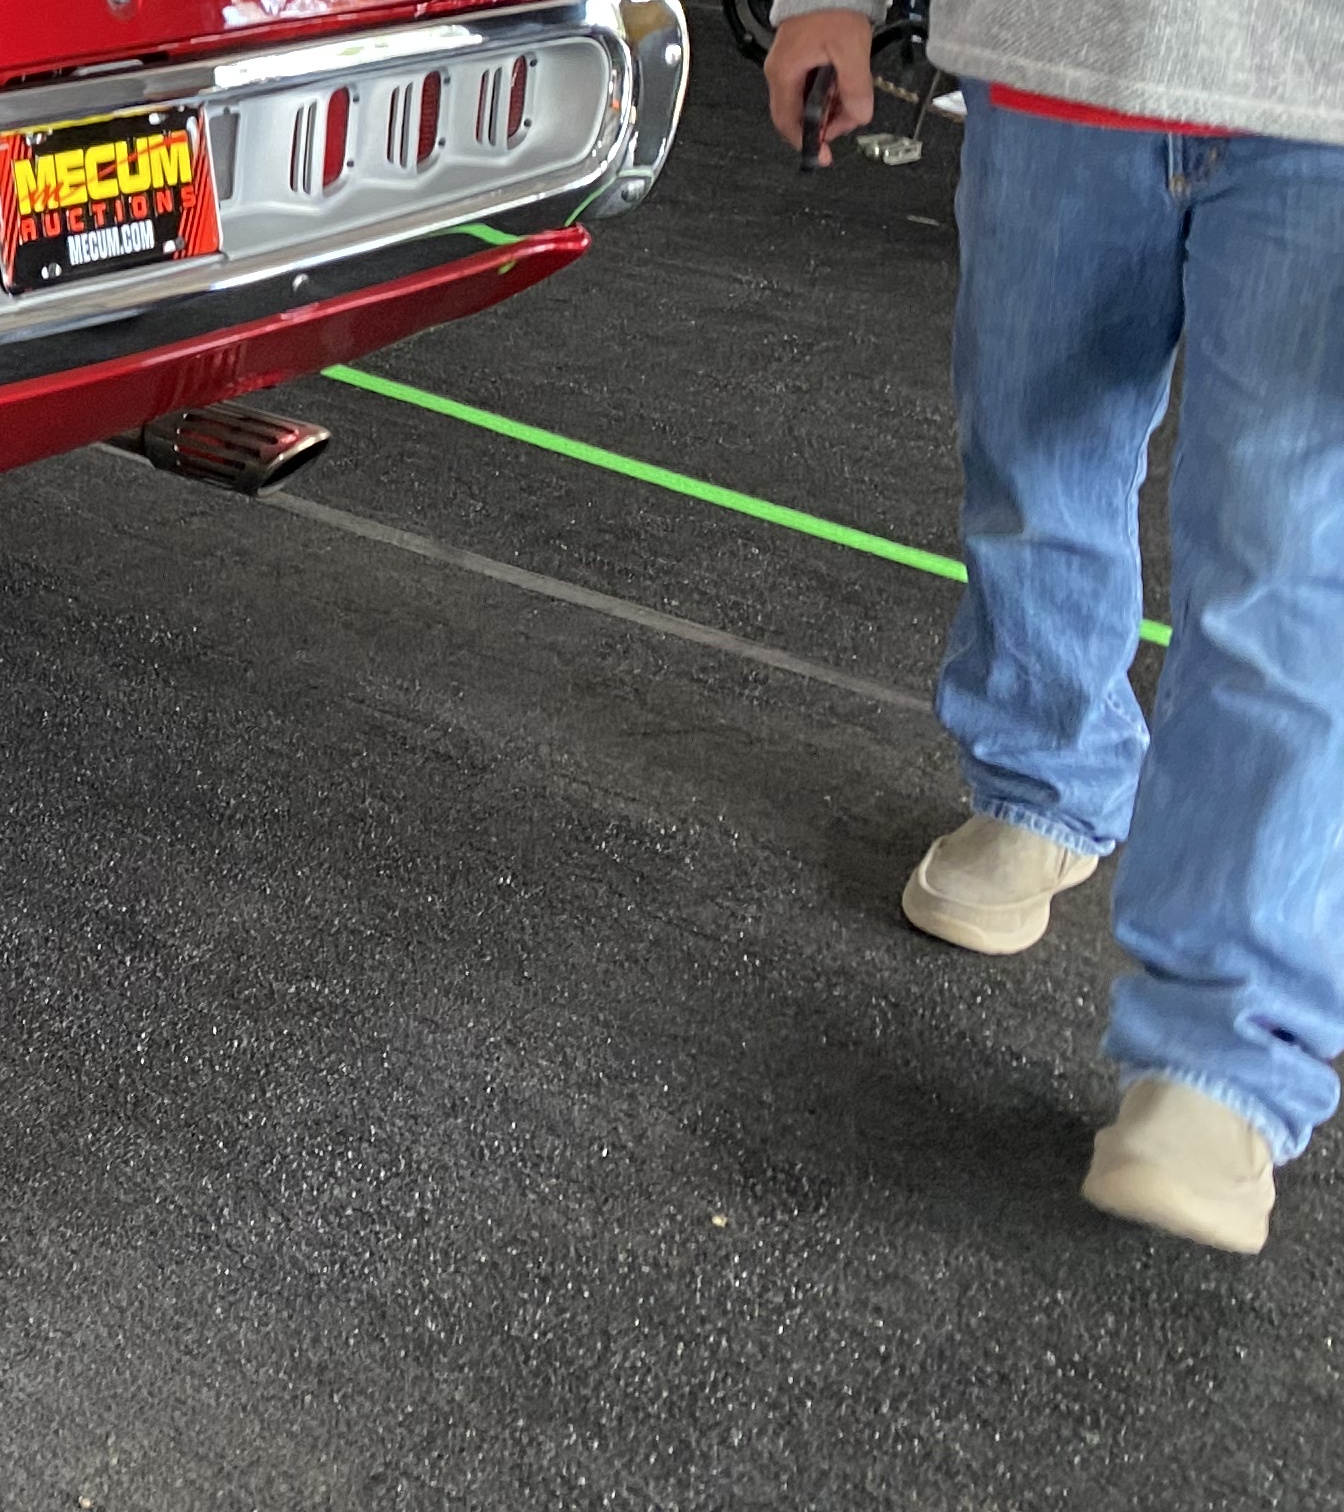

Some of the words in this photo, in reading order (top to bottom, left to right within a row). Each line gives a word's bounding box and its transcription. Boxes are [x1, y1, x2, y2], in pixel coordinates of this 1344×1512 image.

[14, 129, 193, 216] MECUM
[19, 185, 197, 245] AUCTIONS
[67, 218, 156, 267] MECUM.COM
